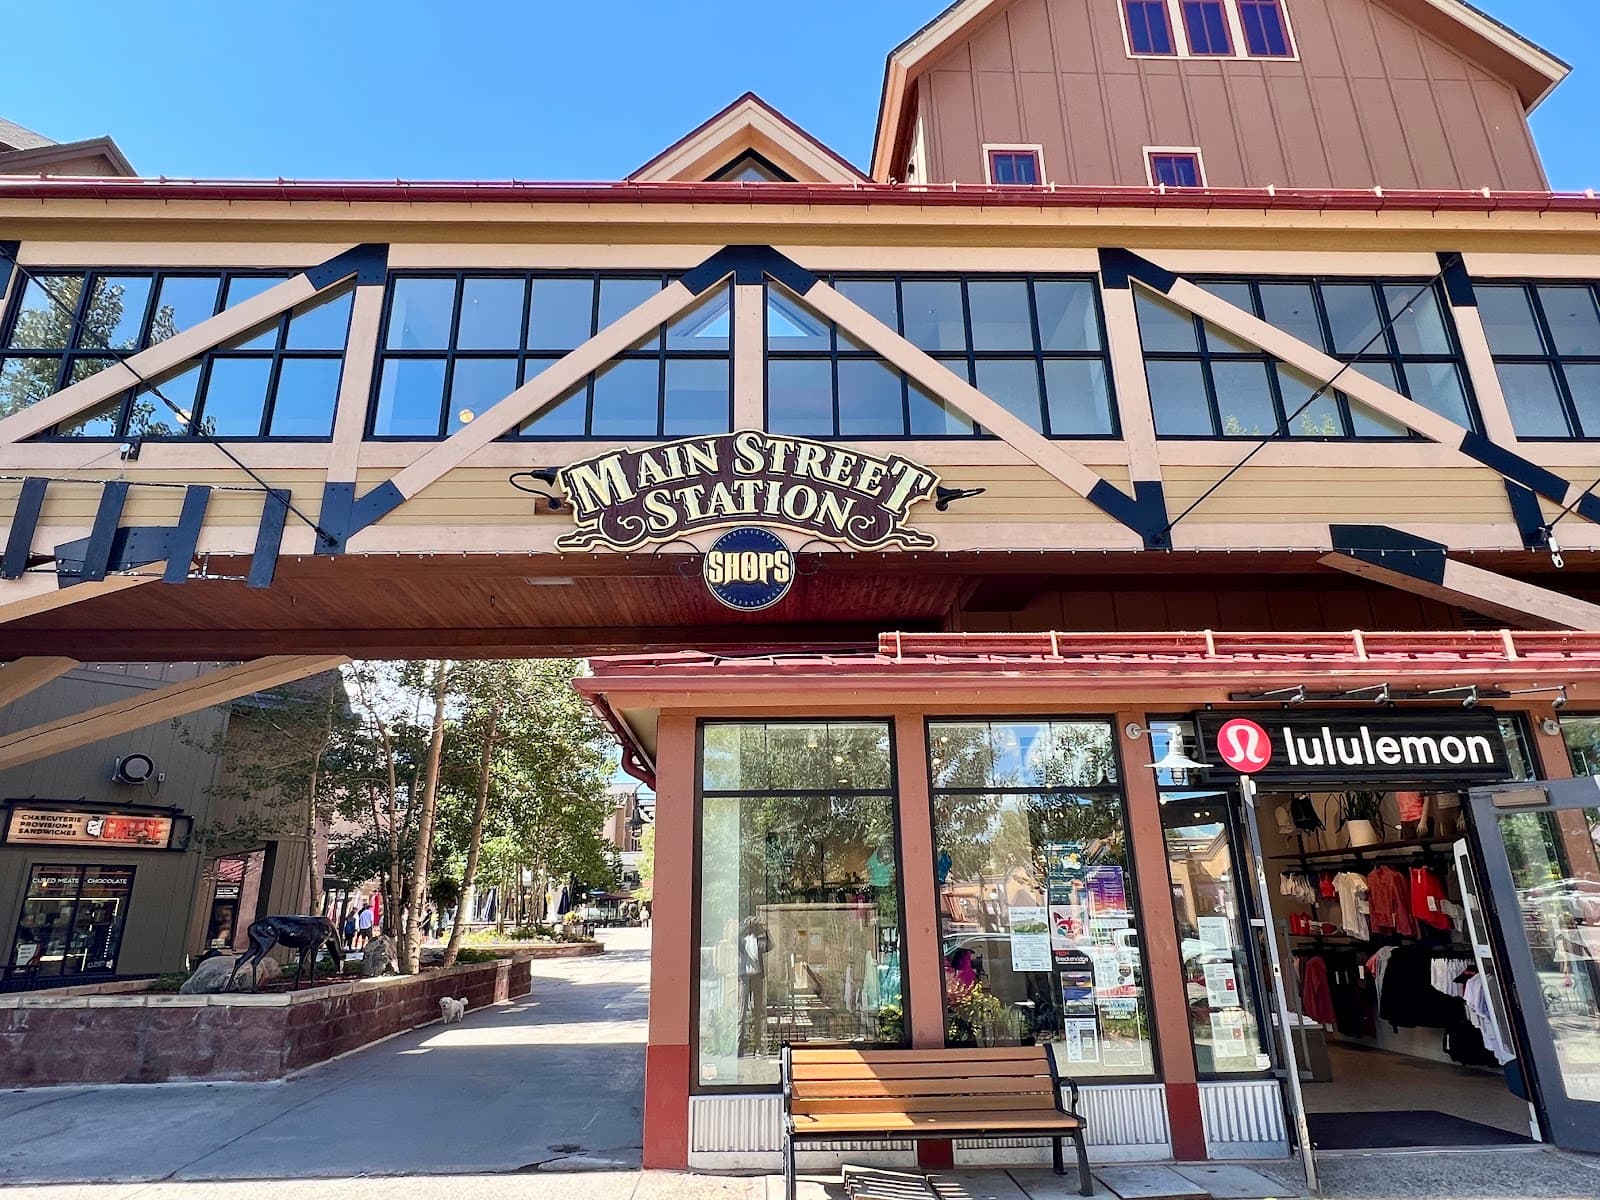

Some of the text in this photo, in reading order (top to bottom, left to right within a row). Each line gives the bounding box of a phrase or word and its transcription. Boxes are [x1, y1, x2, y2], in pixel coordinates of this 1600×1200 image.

[569, 432, 935, 515] MAIN STREET
[643, 479, 858, 532] STATION
[708, 550, 790, 587] SHOPS
[1282, 725, 1495, 767] lululemon
[20, 821, 74, 829] PROVISIONS
[21, 814, 82, 823] CHARCUTERIE
[18, 828, 77, 836] SANDWICHES
[57, 877, 80, 885] MEATS
